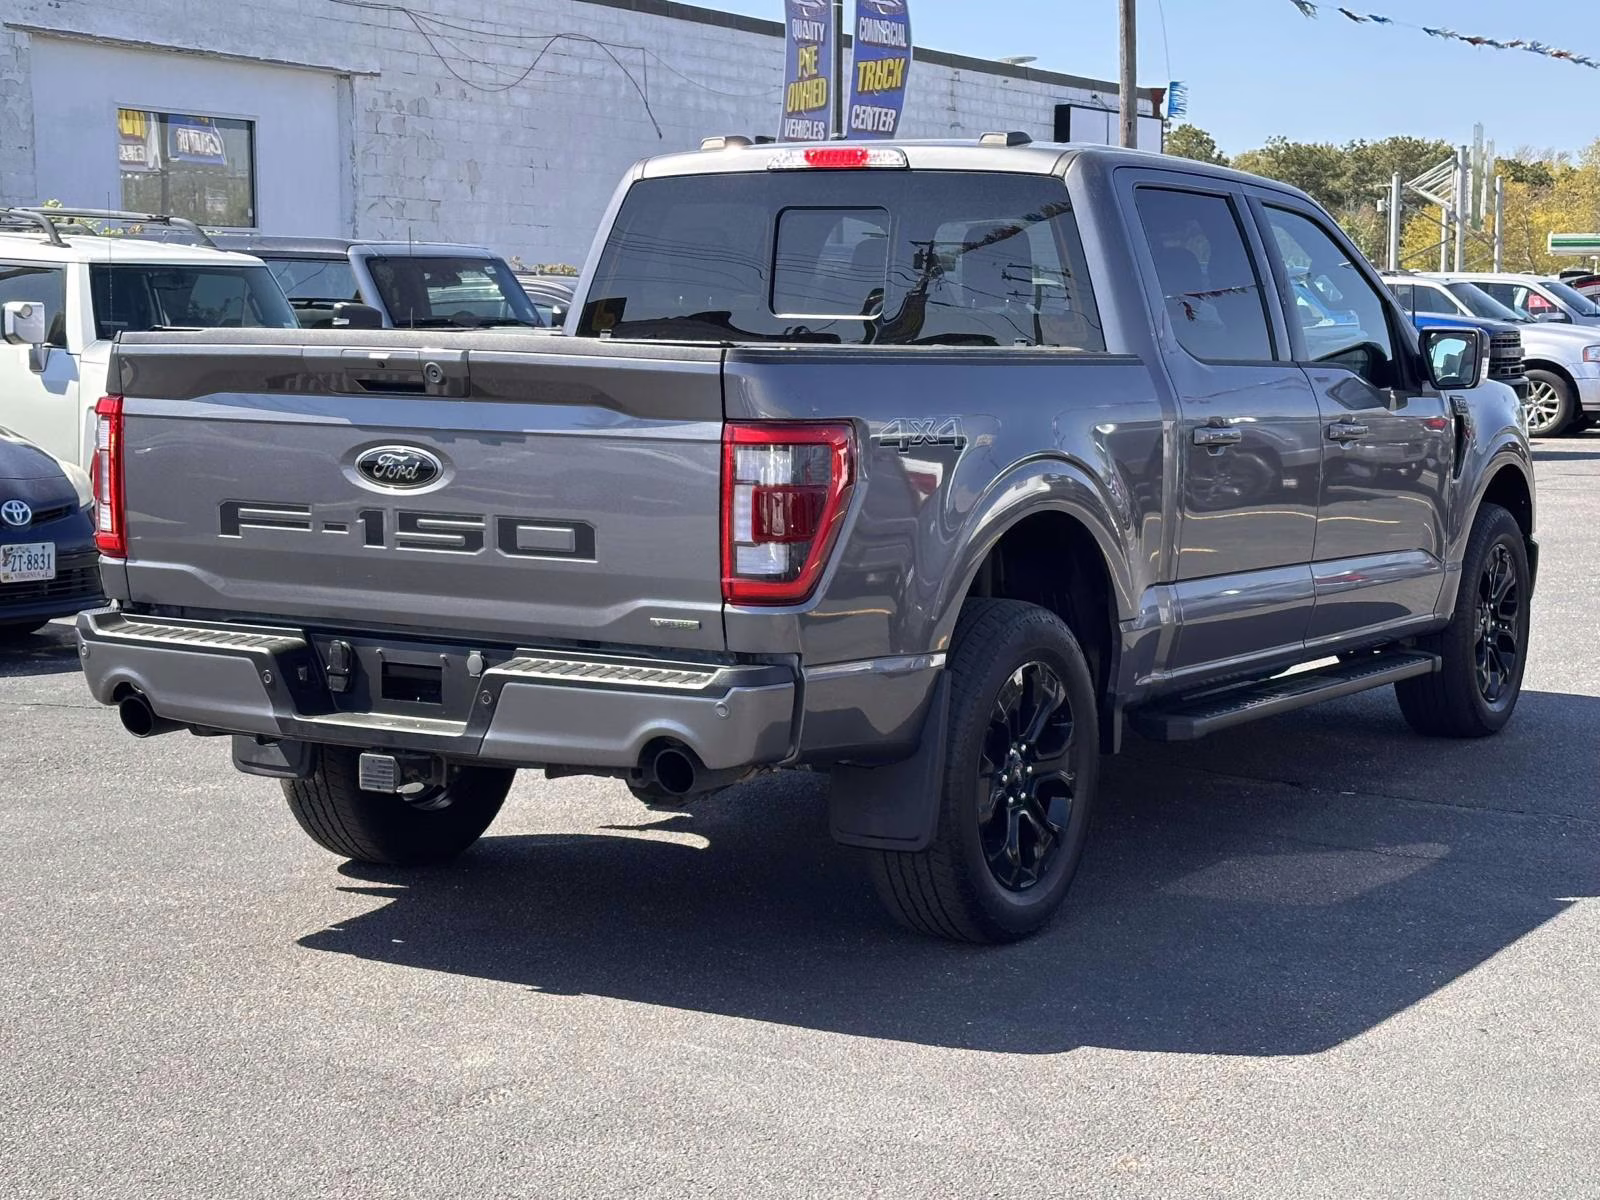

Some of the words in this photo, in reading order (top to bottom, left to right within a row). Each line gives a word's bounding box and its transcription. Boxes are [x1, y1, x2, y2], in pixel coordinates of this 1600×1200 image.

[792, 18, 825, 42] QUALITY
[859, 17, 907, 47] COMMERCIAL
[857, 58, 905, 91] TRUCK
[787, 78, 827, 112] OWNED
[785, 118, 825, 140] VEHICLES
[851, 104, 897, 132] CENTER
[372, 453, 421, 480] Ford
[217, 500, 599, 563] F-150
